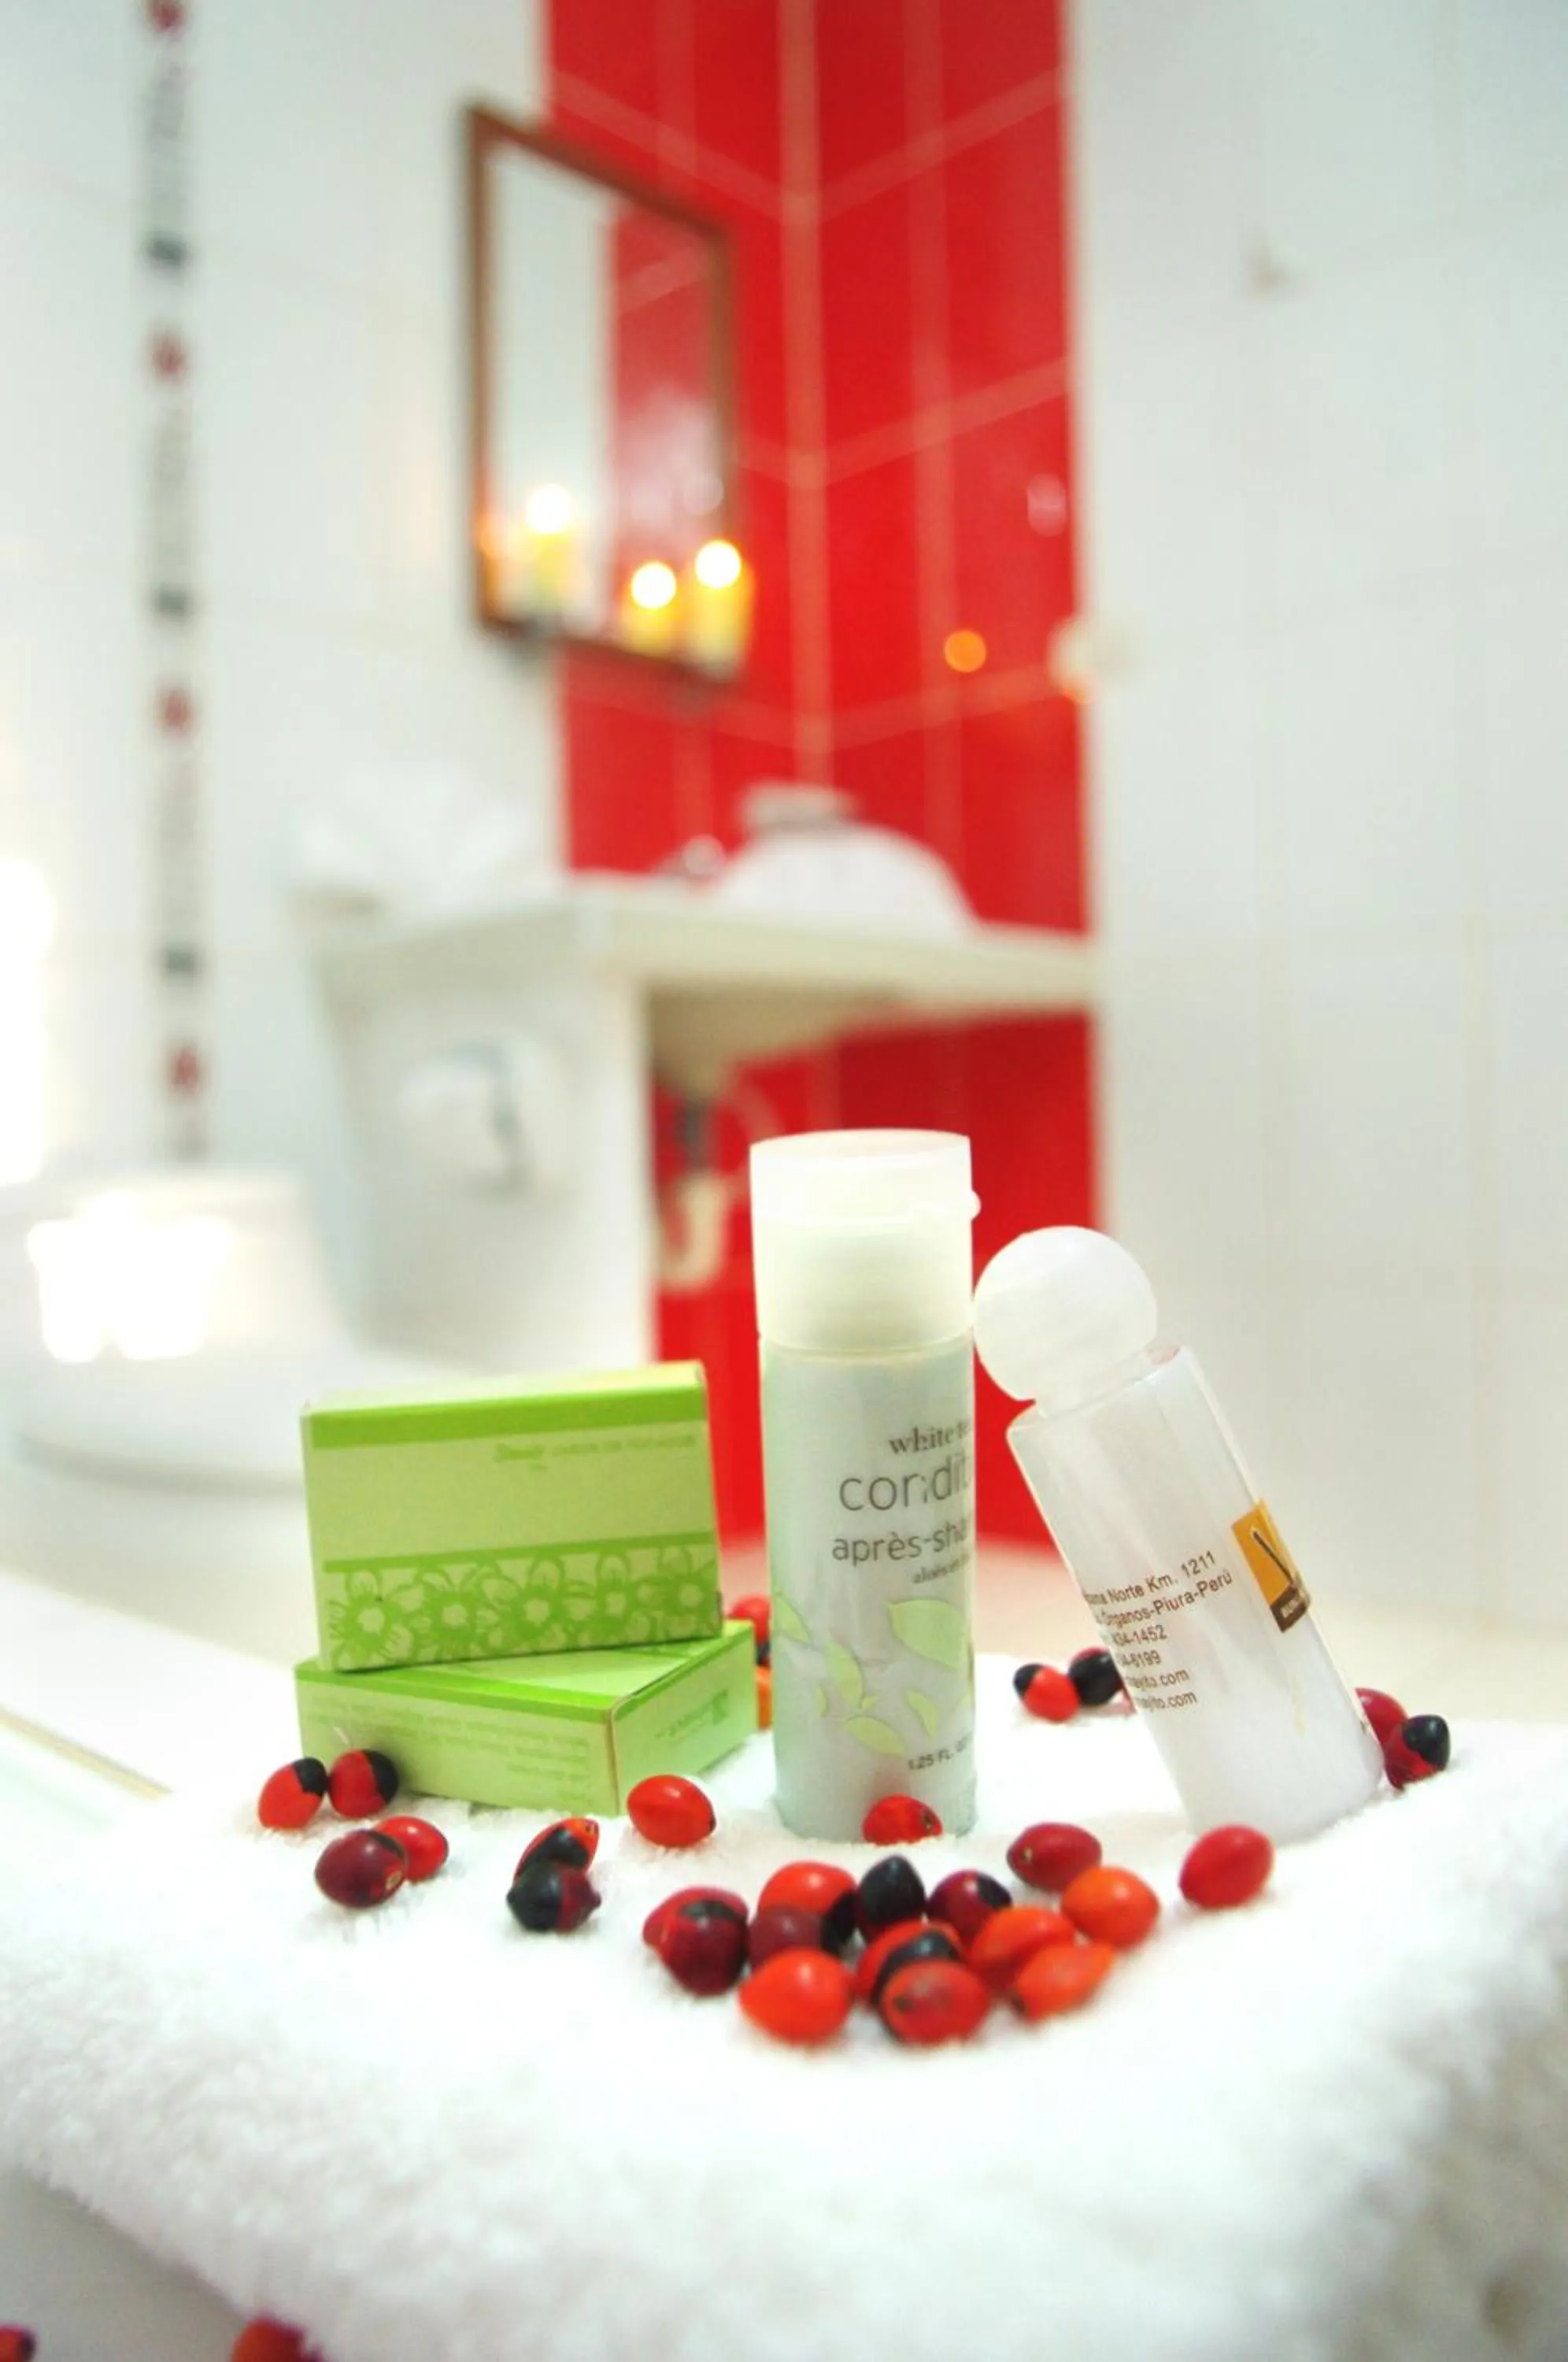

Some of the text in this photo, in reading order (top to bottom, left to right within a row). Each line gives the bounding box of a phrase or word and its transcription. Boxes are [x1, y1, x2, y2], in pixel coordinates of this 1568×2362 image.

[889, 1425, 955, 1455] white
[1106, 1584, 1145, 1603] Norte
[1145, 1573, 1178, 1593] Km.
[1181, 1549, 1217, 1579] 1211
